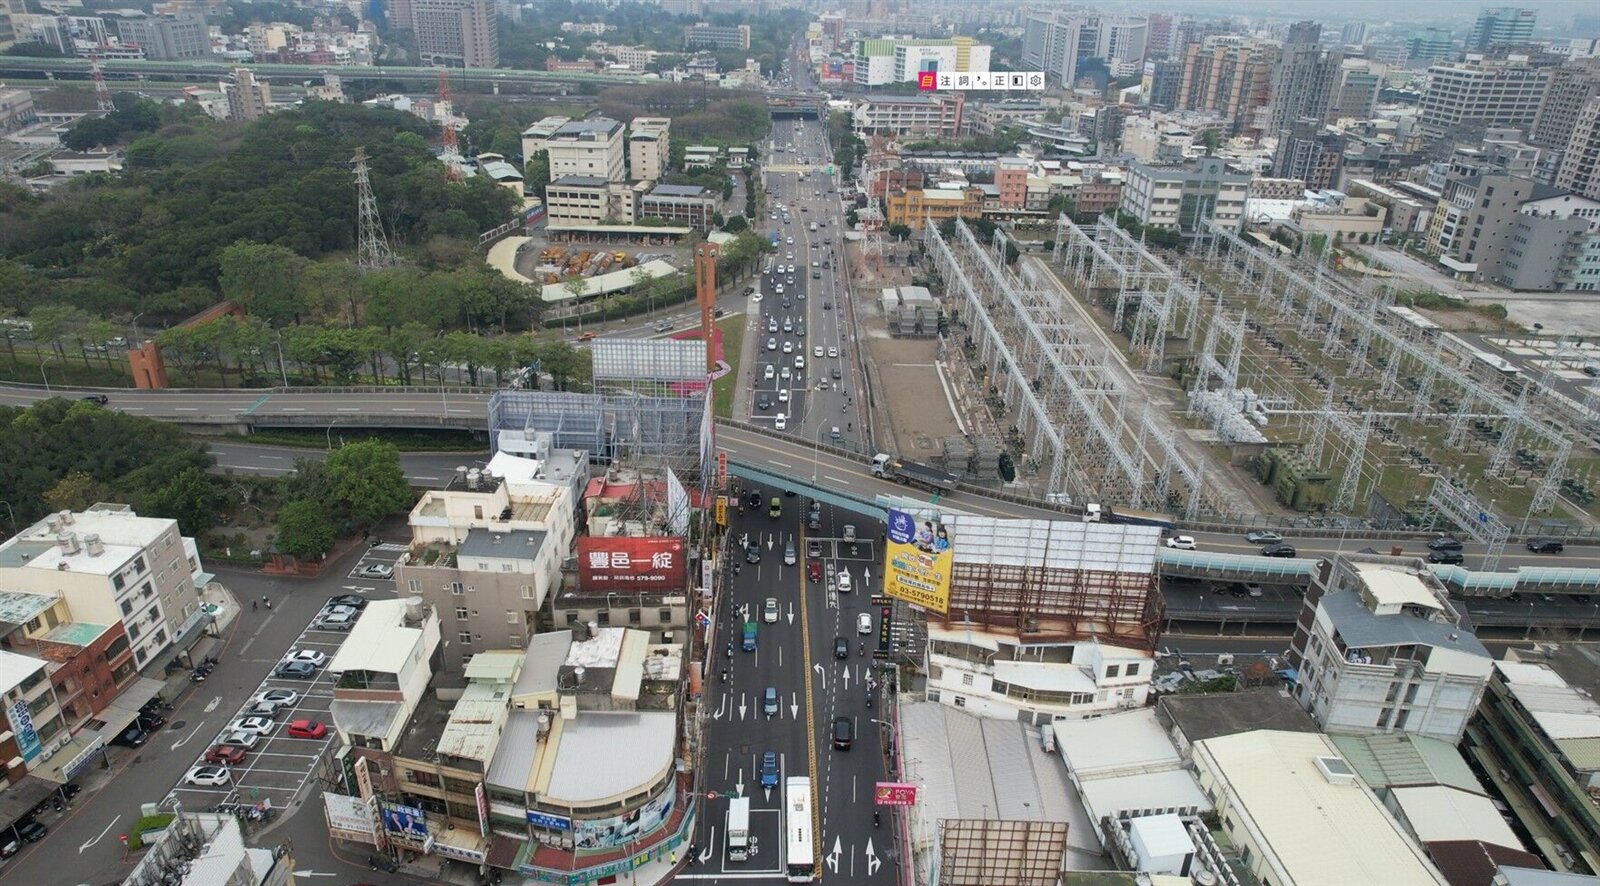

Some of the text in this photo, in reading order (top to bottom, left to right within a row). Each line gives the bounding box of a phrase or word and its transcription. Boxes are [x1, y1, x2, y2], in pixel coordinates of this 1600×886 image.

[589, 551, 673, 569] 豐邑一綻
[899, 586, 944, 604] 03-5790518
